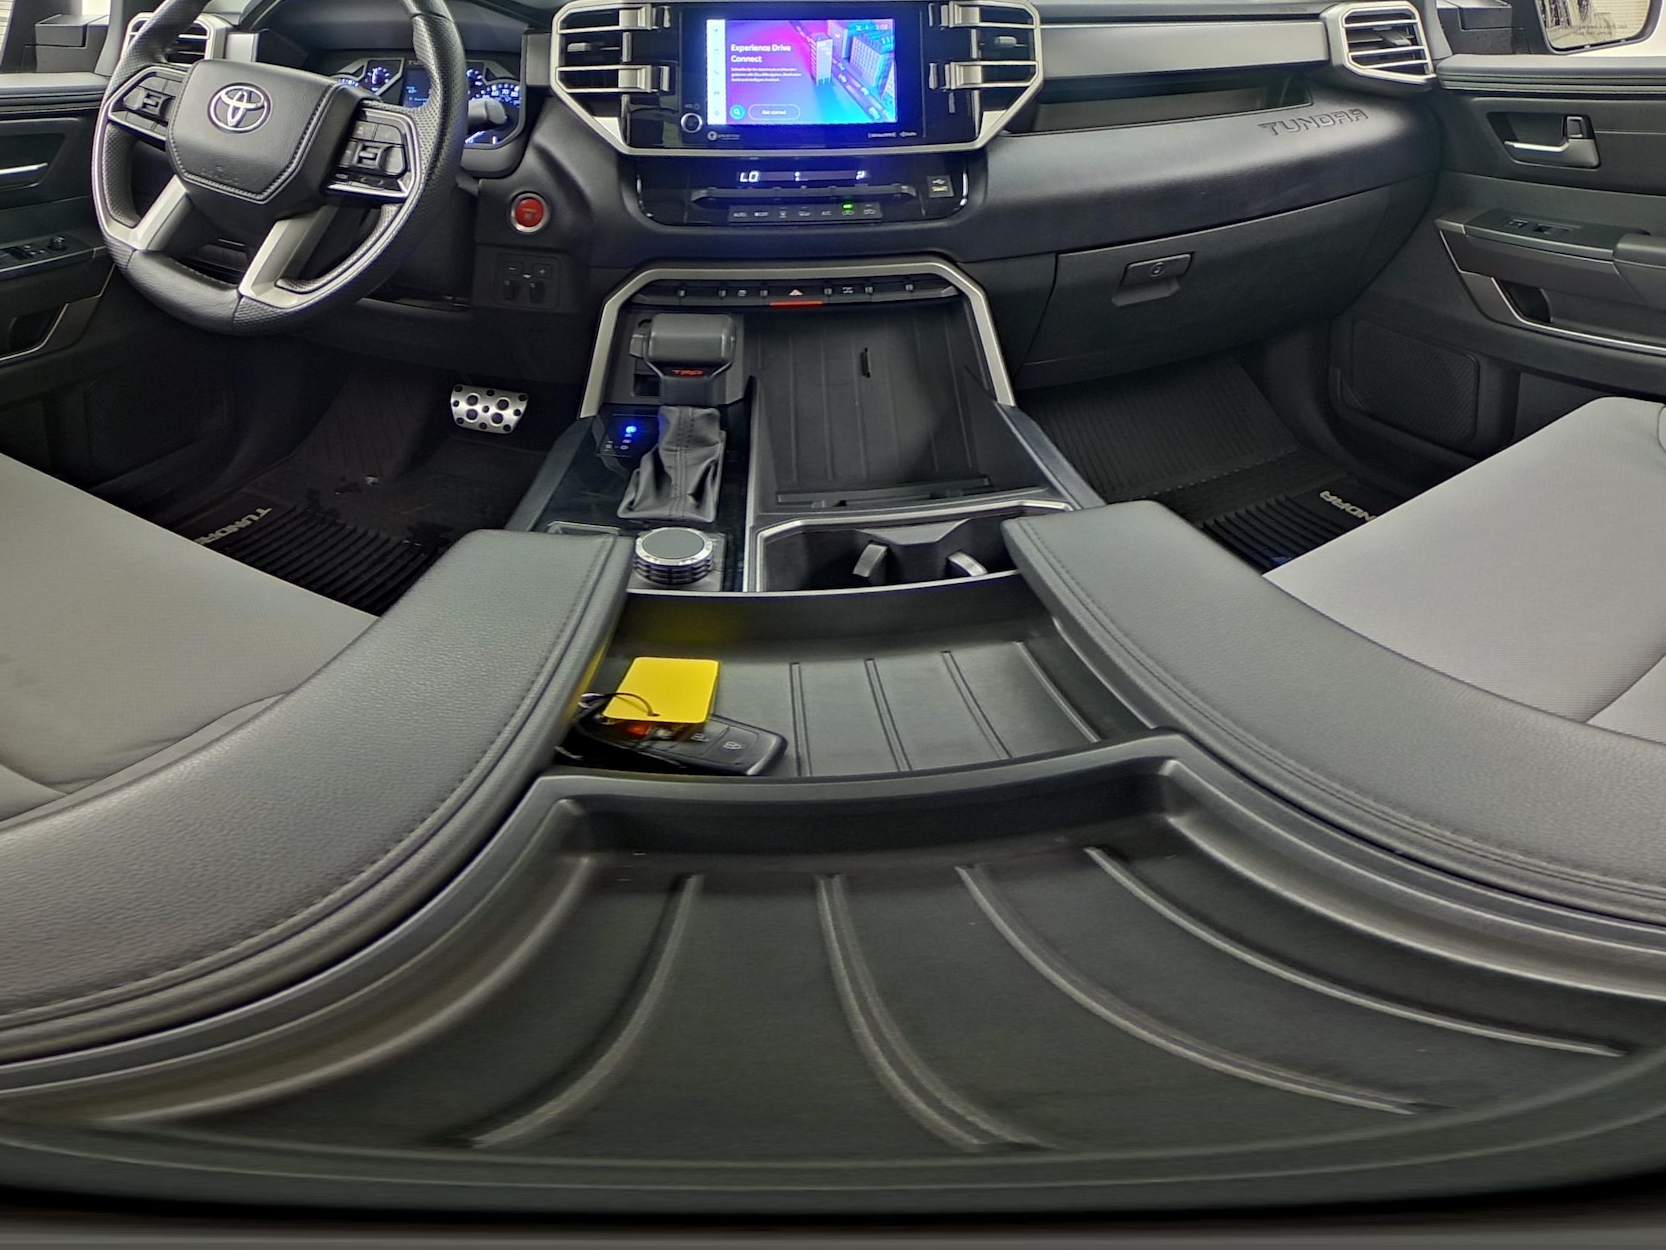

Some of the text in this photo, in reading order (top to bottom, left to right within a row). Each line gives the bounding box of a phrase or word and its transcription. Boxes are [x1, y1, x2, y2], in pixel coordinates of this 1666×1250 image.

[731, 44, 791, 53] Experience Drive
[731, 55, 763, 63] Connect
[1258, 108, 1369, 137] TUNDRA
[1319, 490, 1376, 521] NDRA
